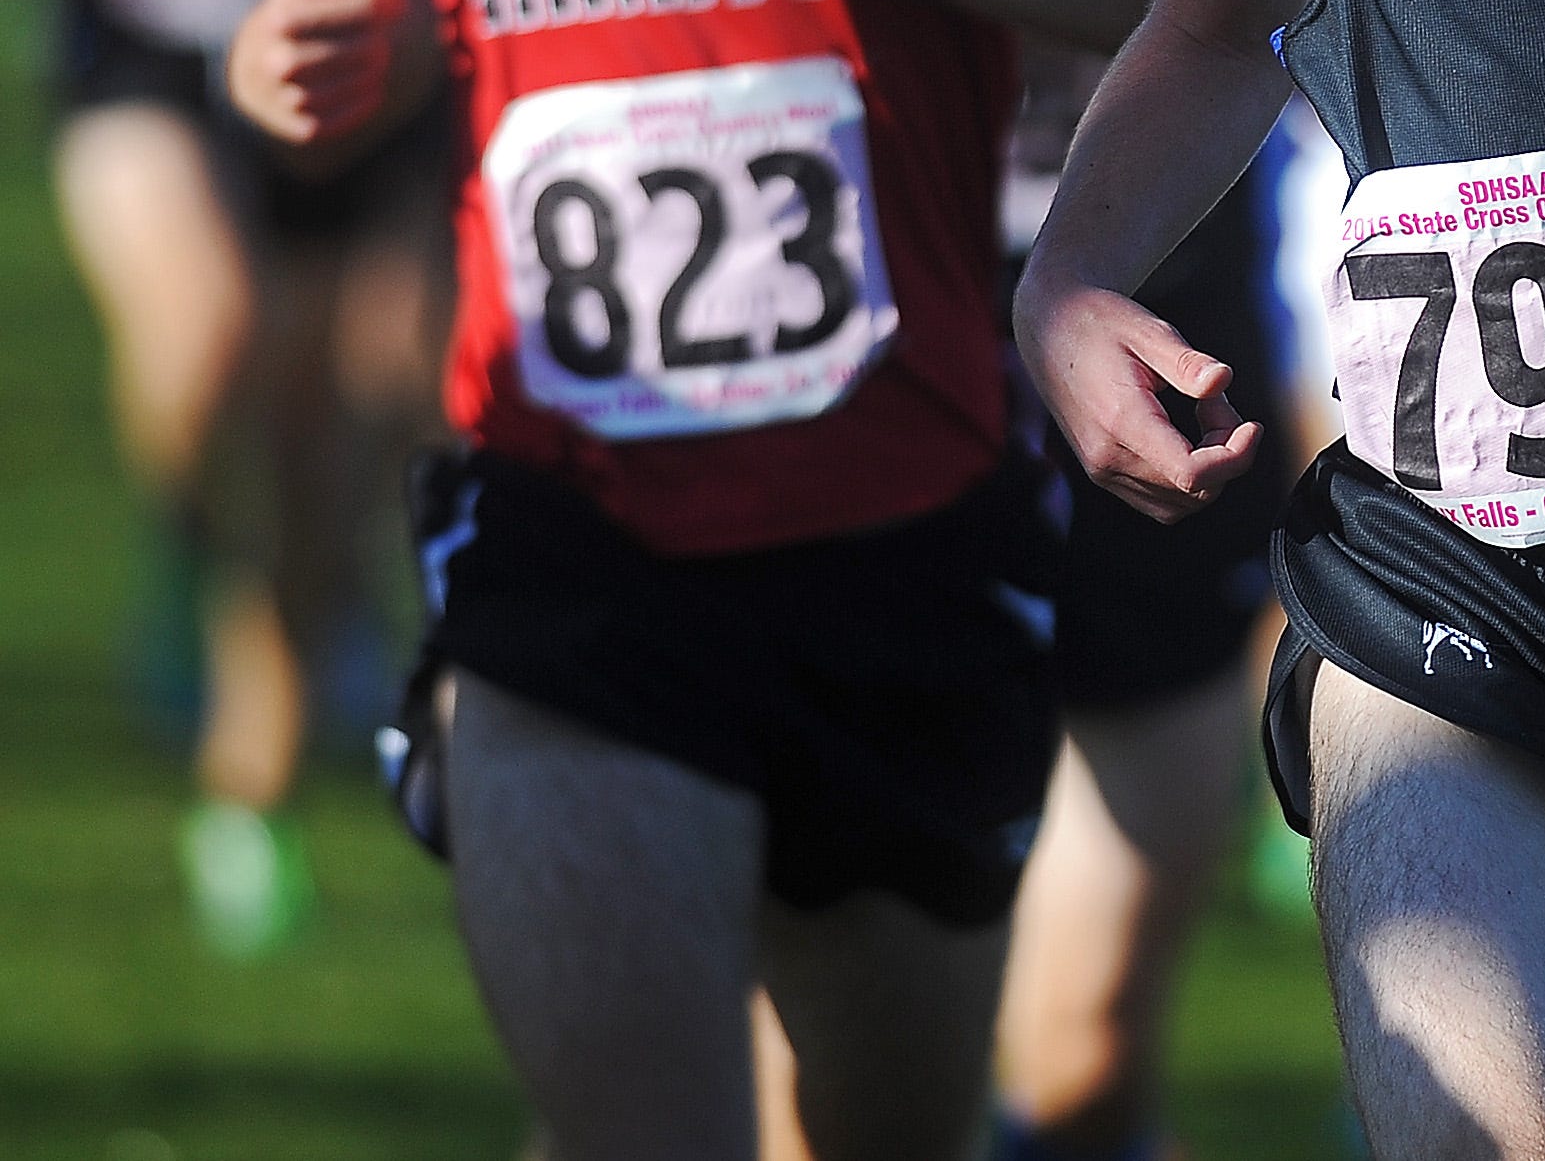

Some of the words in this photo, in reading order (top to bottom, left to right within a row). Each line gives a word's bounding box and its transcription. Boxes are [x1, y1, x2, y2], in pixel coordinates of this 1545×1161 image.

[1342, 215, 1393, 241] 2015
[1398, 211, 1458, 235] State
[1463, 205, 1530, 231] Cross
[534, 149, 858, 380] 823
[1461, 500, 1519, 528] Falls
